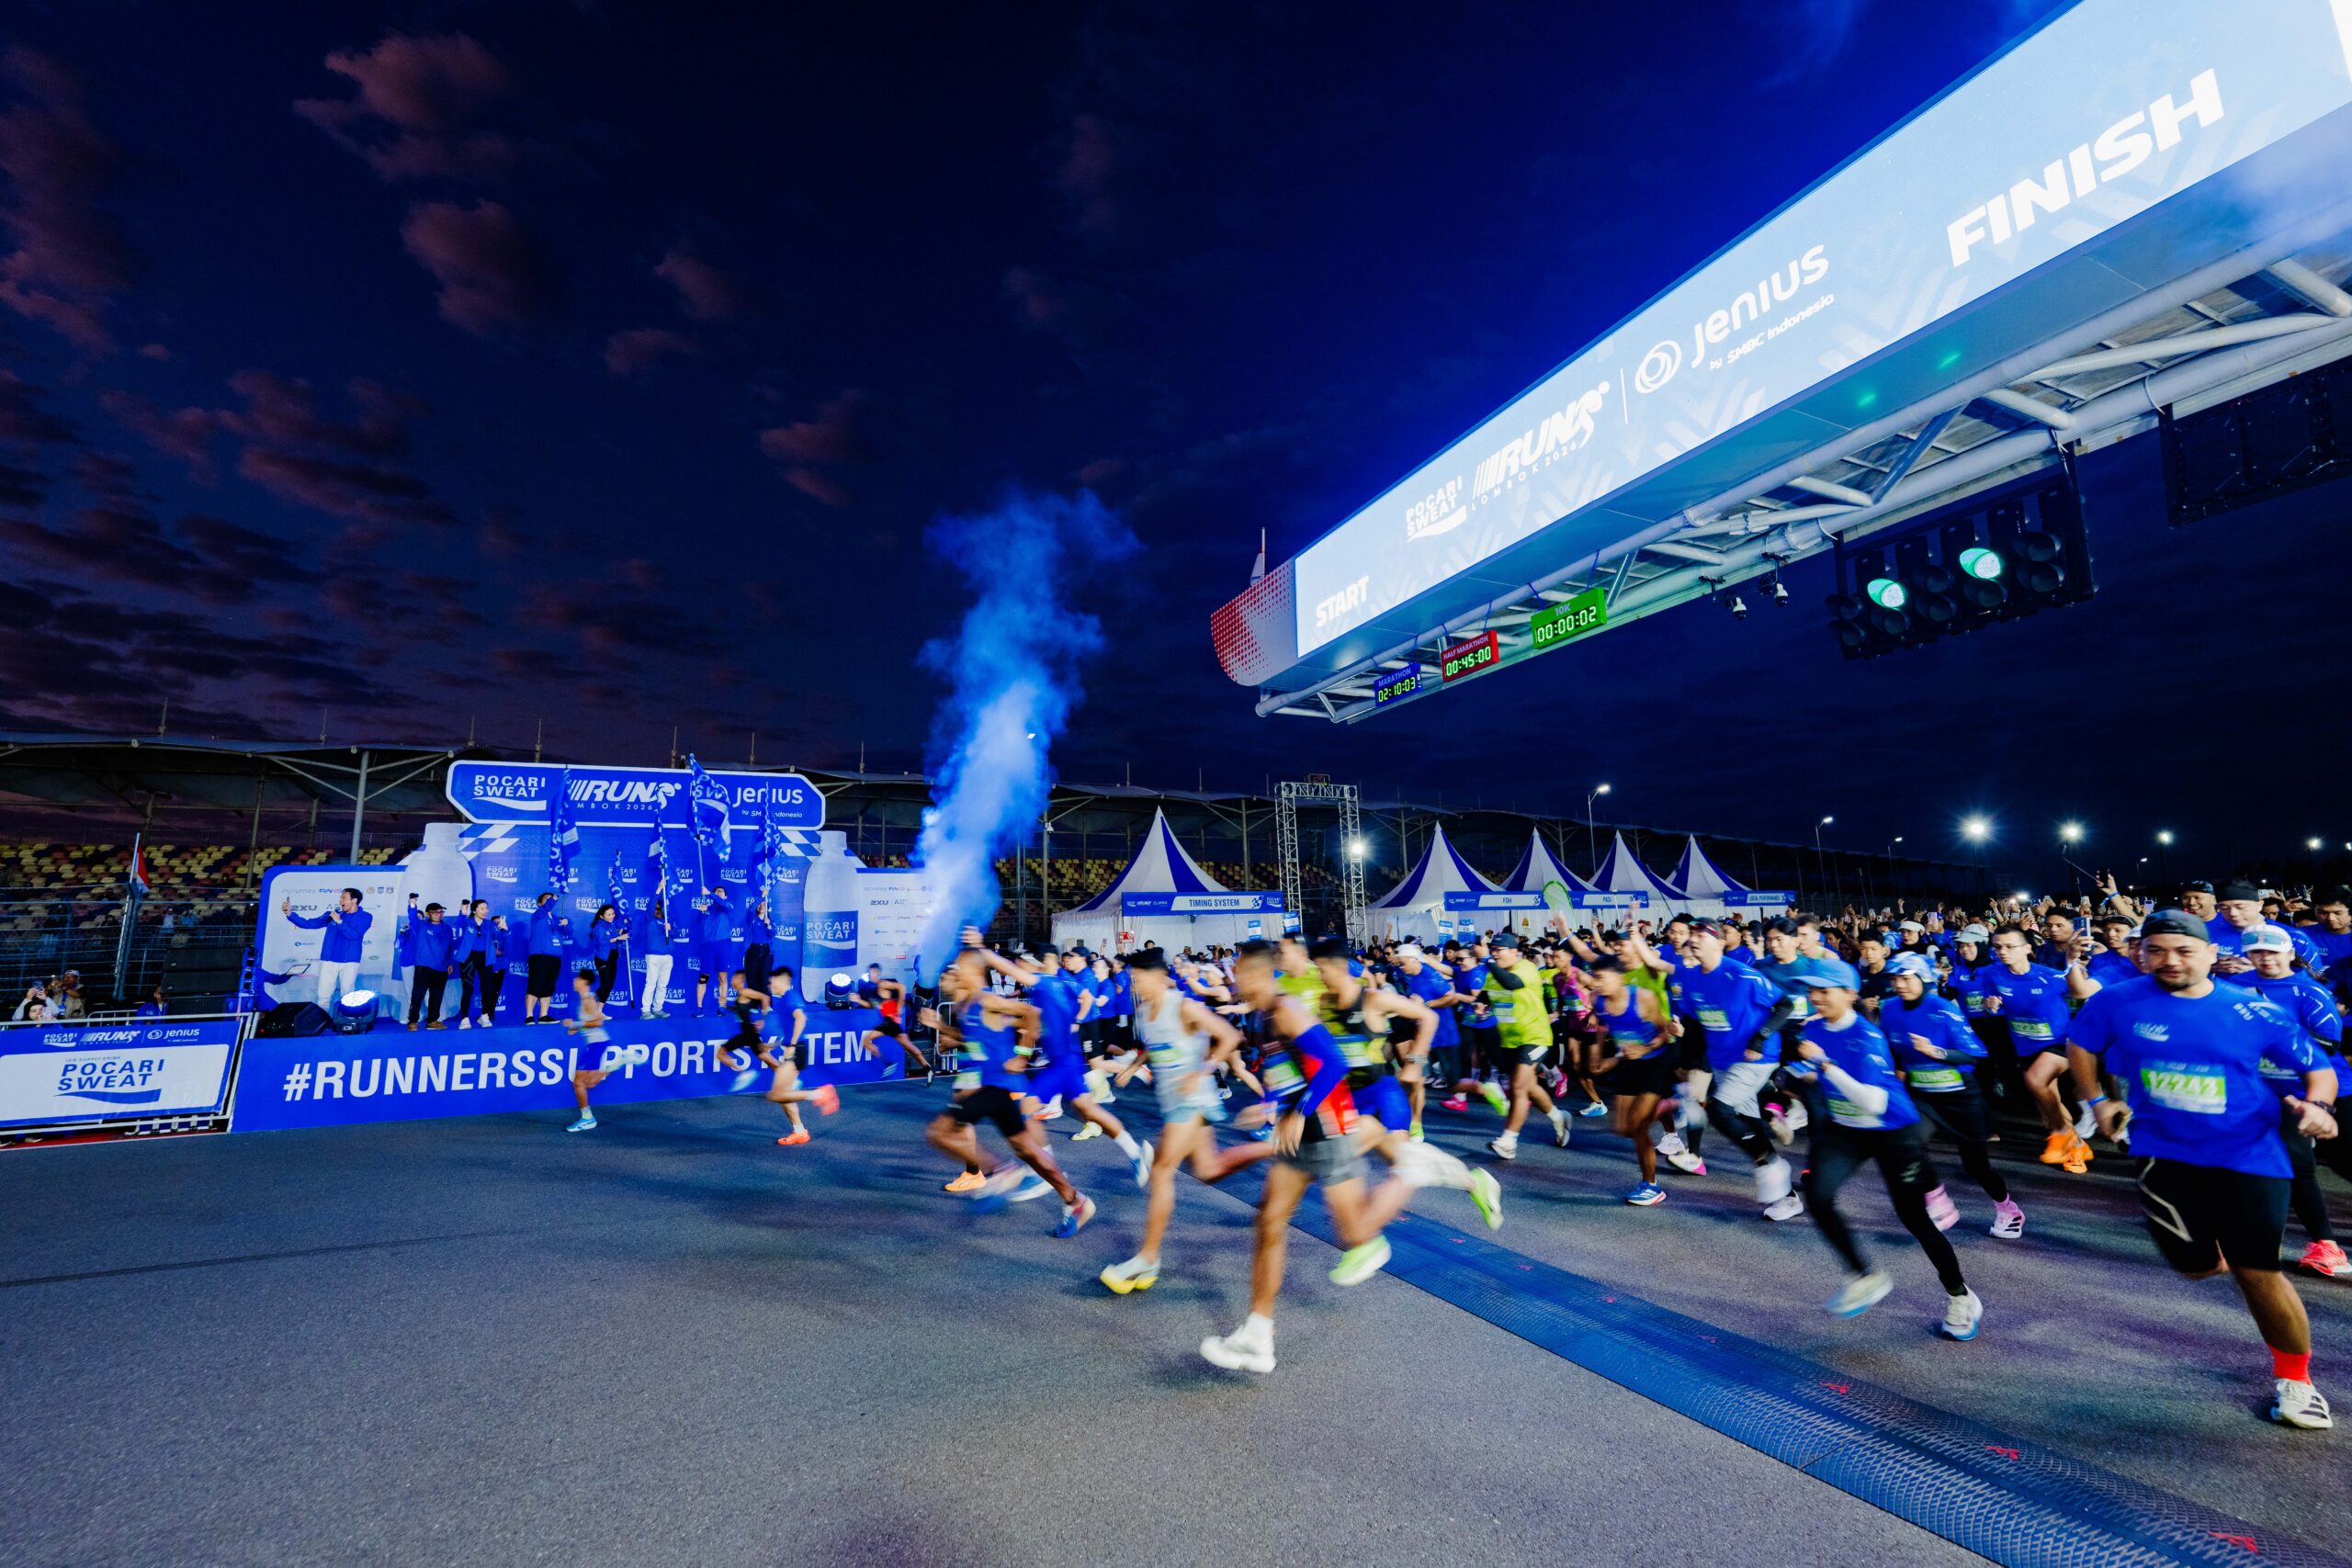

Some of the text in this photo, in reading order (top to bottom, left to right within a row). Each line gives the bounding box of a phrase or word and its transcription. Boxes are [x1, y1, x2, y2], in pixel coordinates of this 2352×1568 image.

[1947, 67, 2225, 268] FINISH
[1710, 293, 1835, 370] by SMBC Indonesia
[1471, 441, 1578, 511] LOMBOK 2026
[1406, 475, 1463, 522] POCARI
[1407, 494, 1457, 536] SWEAT
[1316, 575, 1370, 628] START
[1555, 602, 1572, 616] 10K
[1537, 605, 1597, 644] 00:00:02
[1443, 635, 1488, 660] HALF MARATHON
[1446, 646, 1491, 677] 00:45:00
[1378, 668, 1411, 687] MARATHON
[1378, 677, 1416, 703] 02:10:03
[473, 786, 538, 797] SWEAT
[474, 775, 546, 787] POCARI
[806, 921, 854, 931] POCARI
[806, 931, 851, 940] SWEAT
[61, 1059, 164, 1077] POCARI
[57, 1073, 153, 1091] SWEAT
